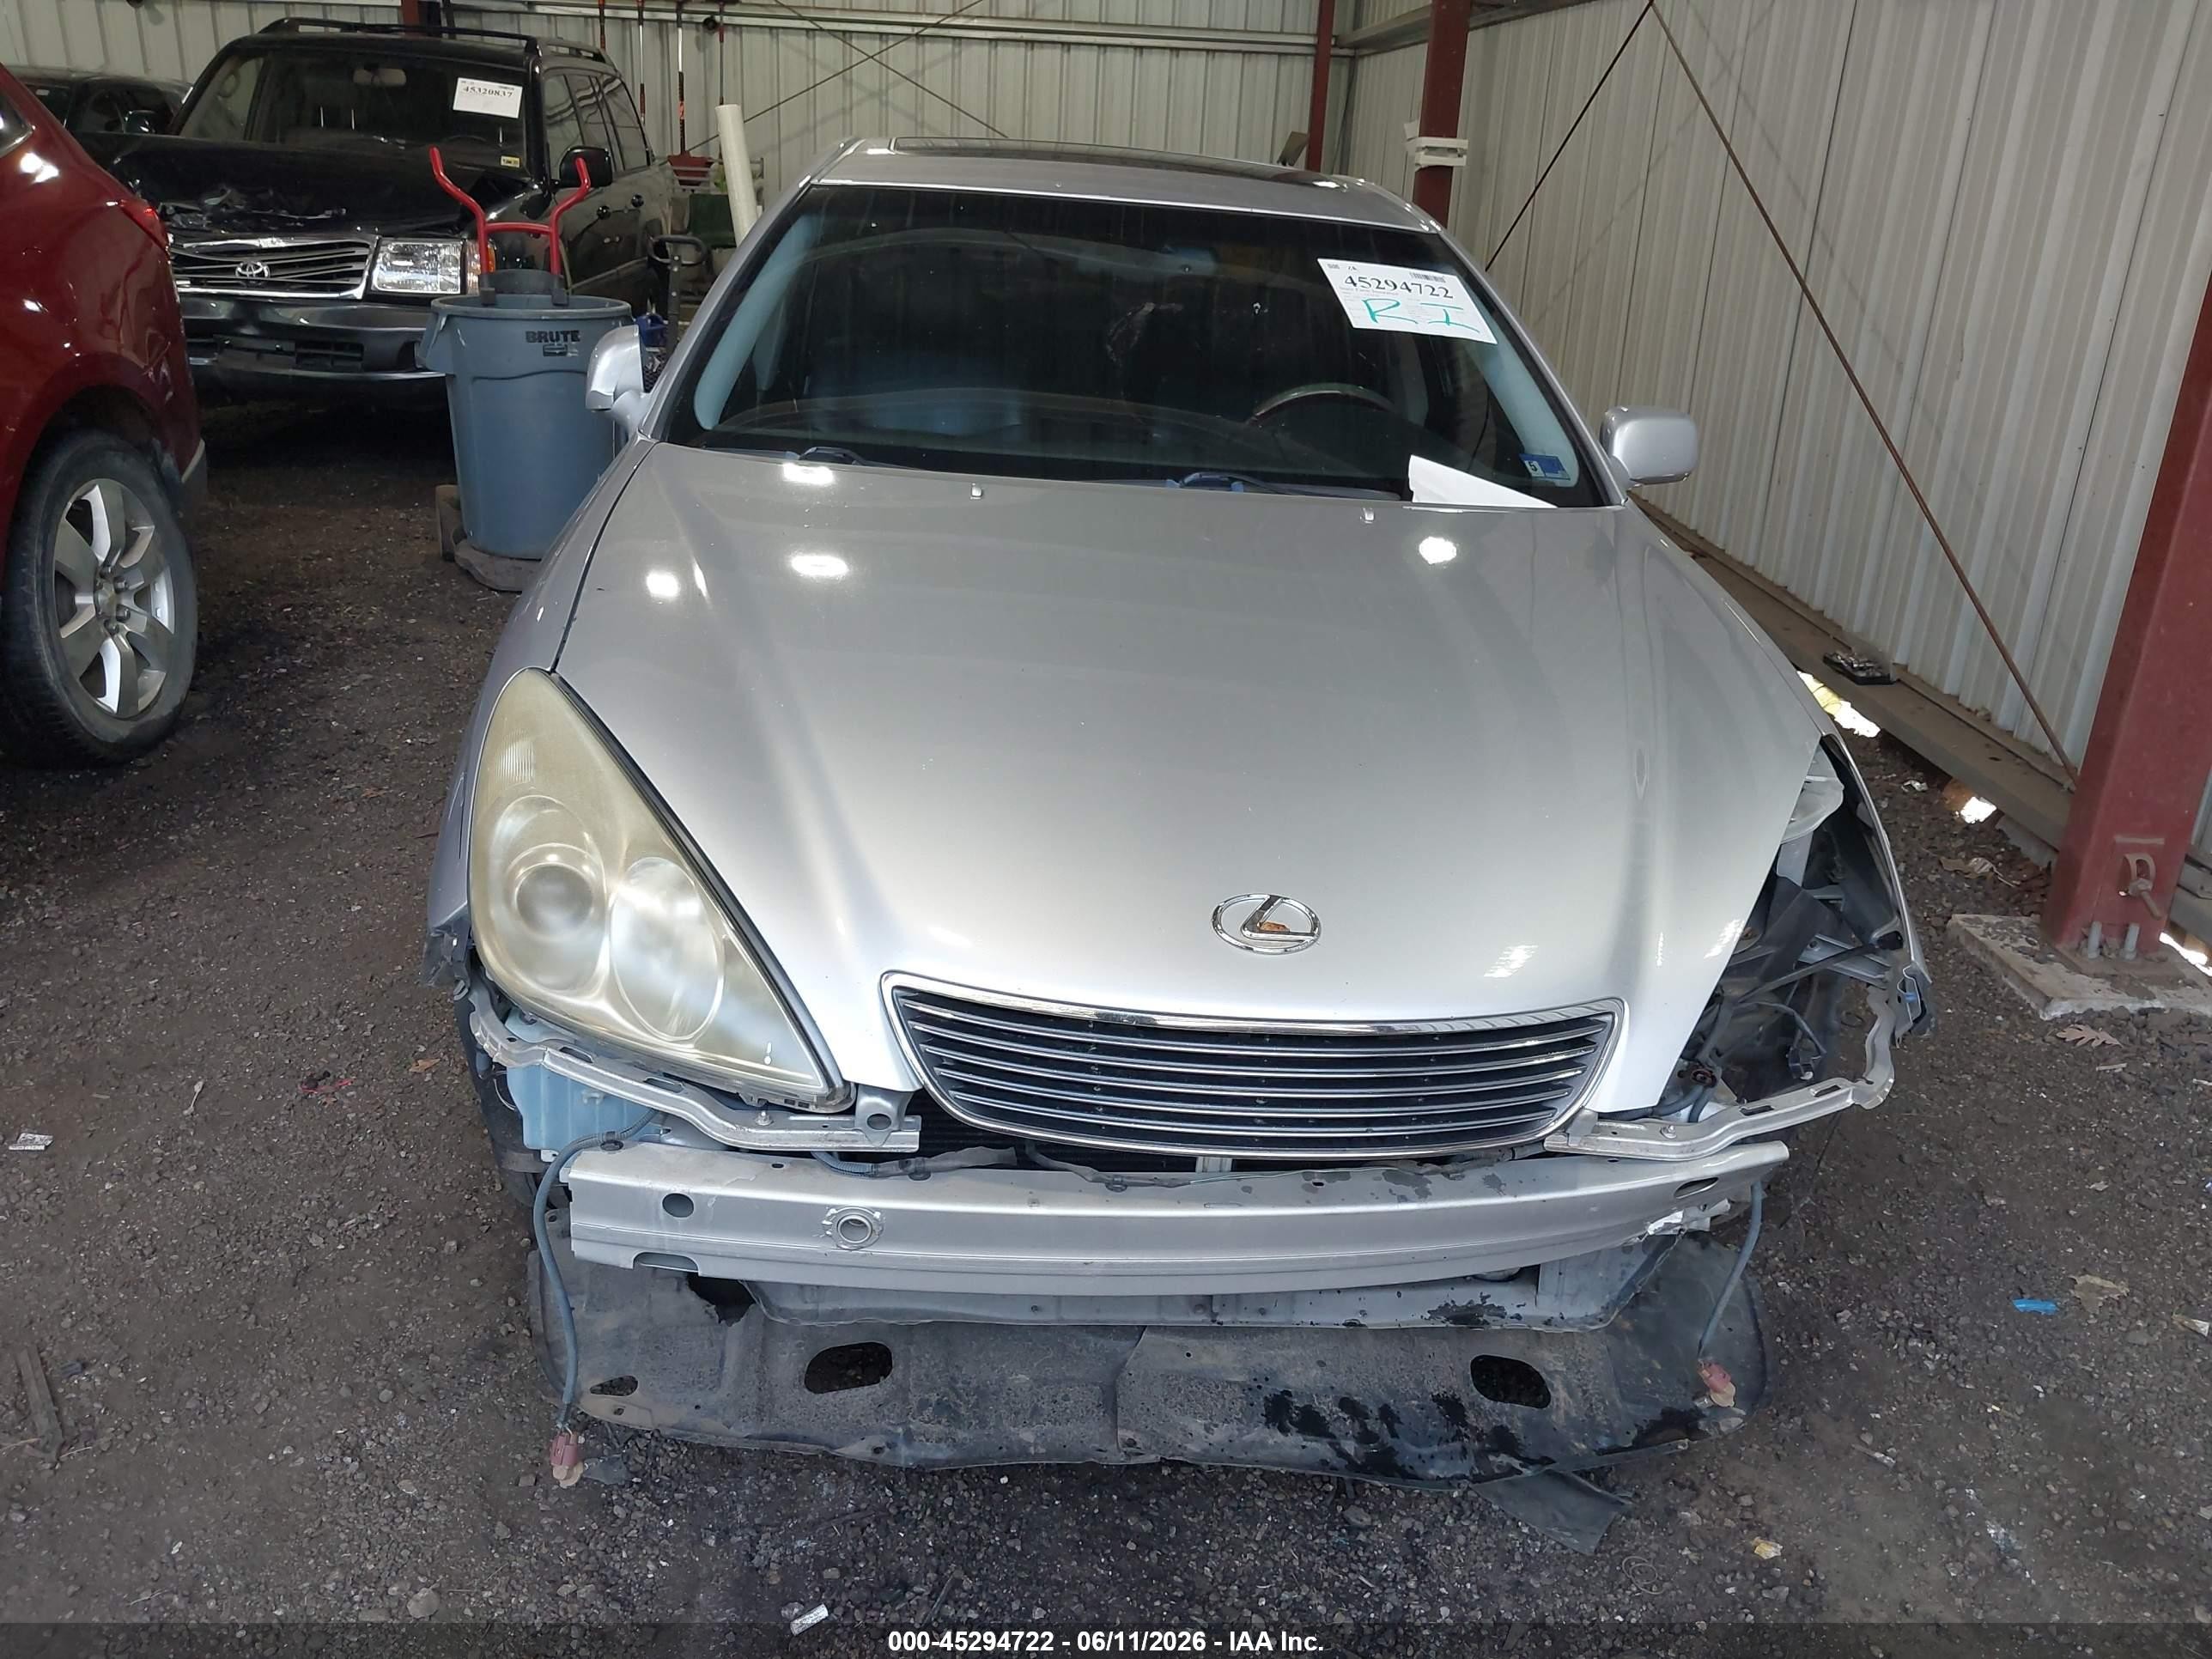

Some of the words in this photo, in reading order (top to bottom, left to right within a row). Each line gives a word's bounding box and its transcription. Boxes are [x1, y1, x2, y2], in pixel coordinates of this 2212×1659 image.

[1344, 275, 1454, 299] 45294722
[526, 330, 580, 343] BRUTE
[1528, 461, 1538, 472] 5
